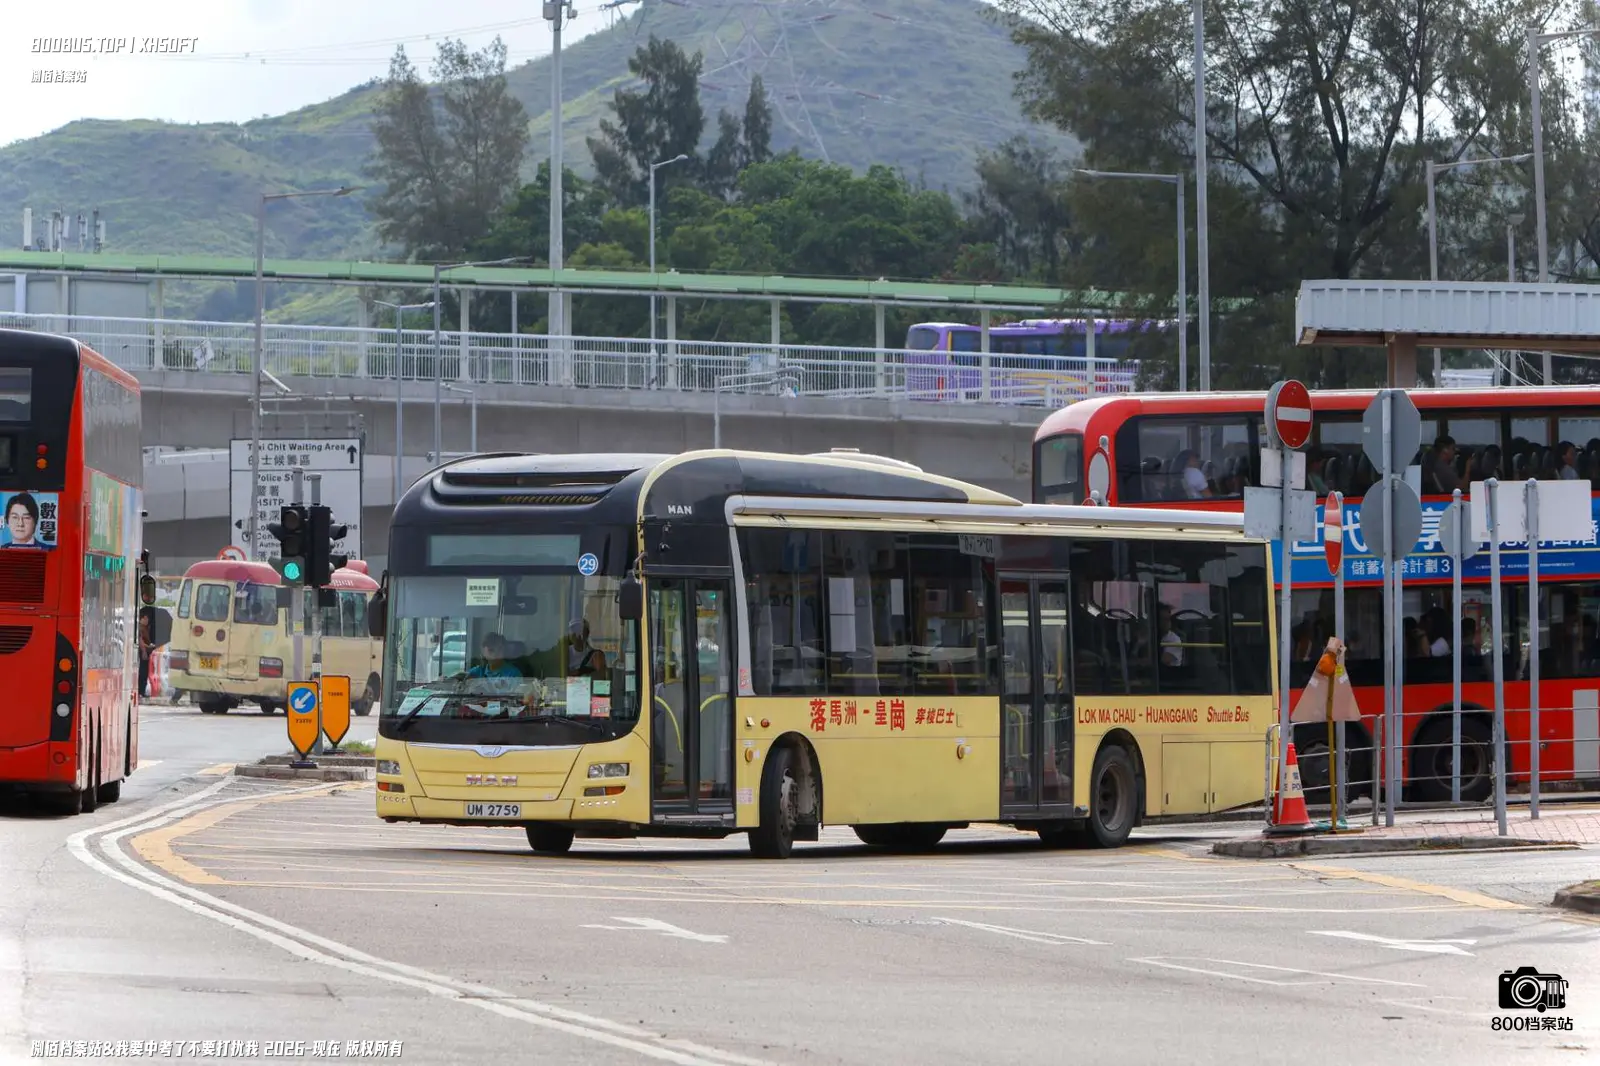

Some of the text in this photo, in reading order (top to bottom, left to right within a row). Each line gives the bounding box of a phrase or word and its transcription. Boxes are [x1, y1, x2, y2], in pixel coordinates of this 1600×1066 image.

[247, 443, 346, 452] Txi Chit Waiting Area
[667, 505, 693, 515] MAN
[580, 558, 596, 571] 29
[915, 707, 954, 724] 穿梭巴士
[1078, 706, 1097, 723] LOK
[1099, 708, 1111, 723] MA
[1113, 708, 1136, 723] CHAU
[1146, 706, 1198, 723] HUANGGANG
[1207, 705, 1233, 723] Shuttle
[1235, 705, 1250, 723] Bus
[467, 805, 519, 816] UM 2759
